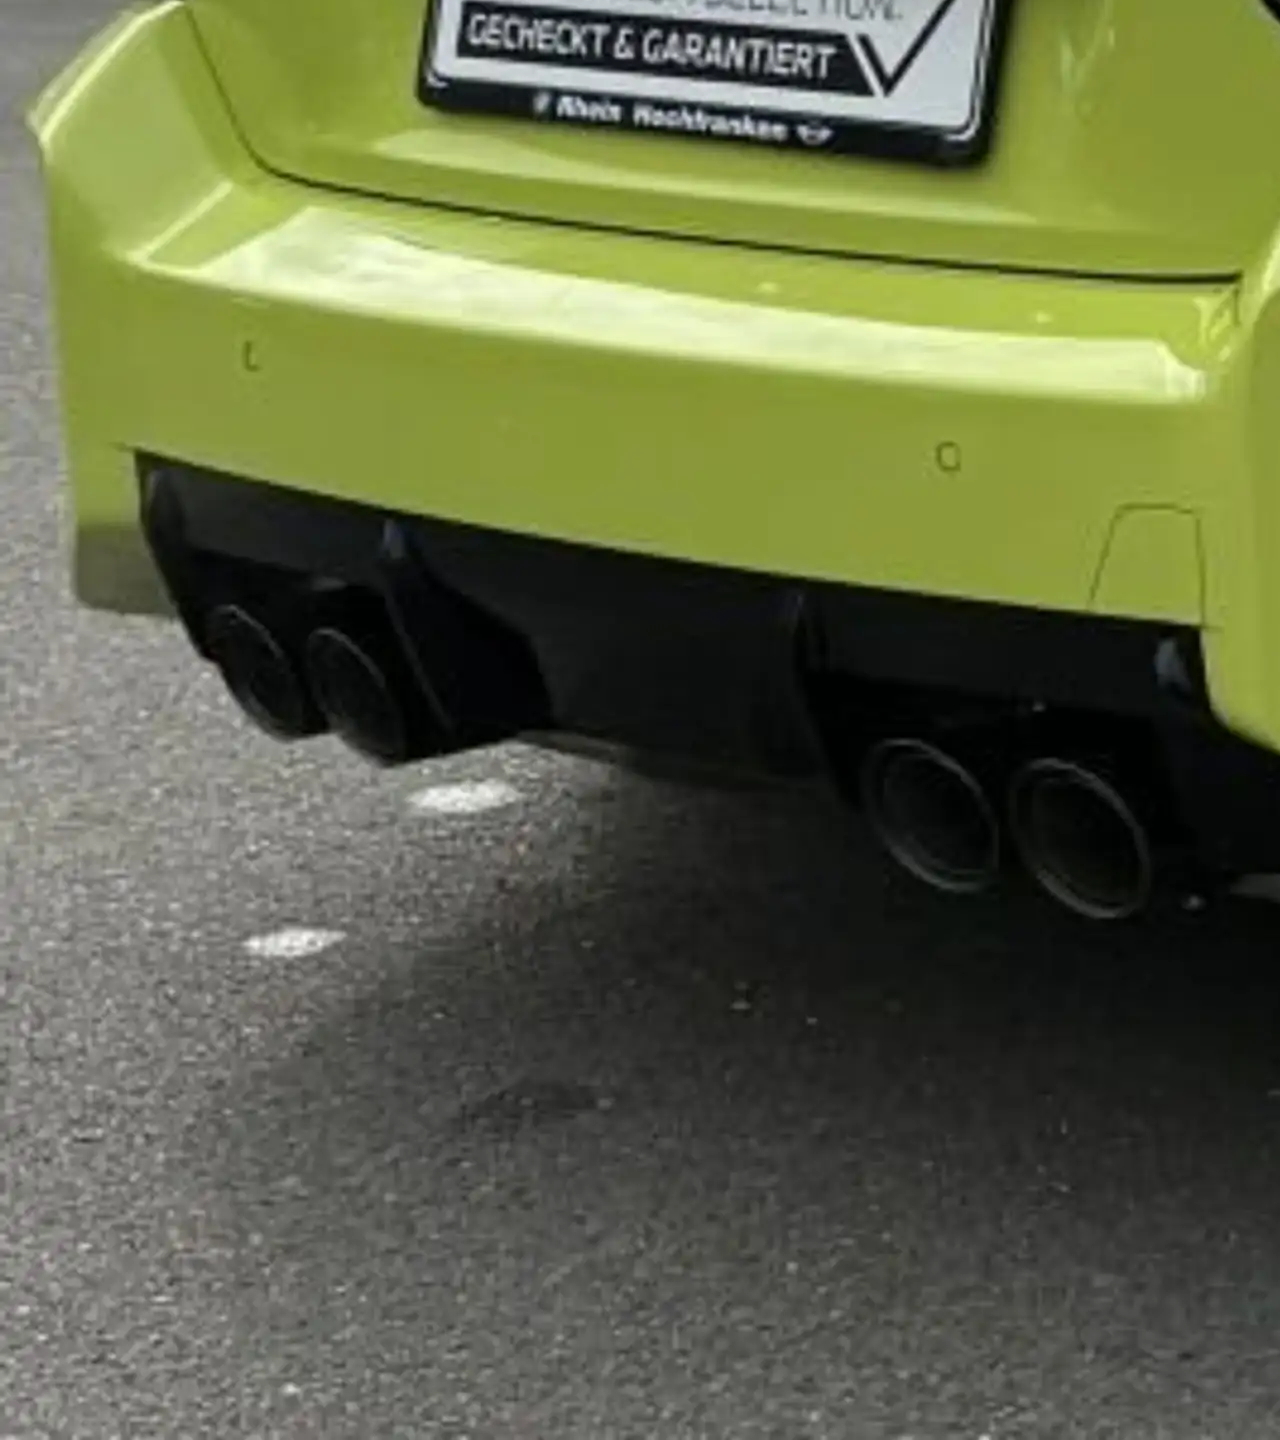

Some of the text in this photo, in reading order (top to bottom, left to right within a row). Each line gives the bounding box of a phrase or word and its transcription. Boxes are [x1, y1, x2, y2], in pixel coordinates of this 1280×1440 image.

[466, 12, 837, 79] GECHECKT & GARANTIERT
[556, 95, 622, 122] Rhein
